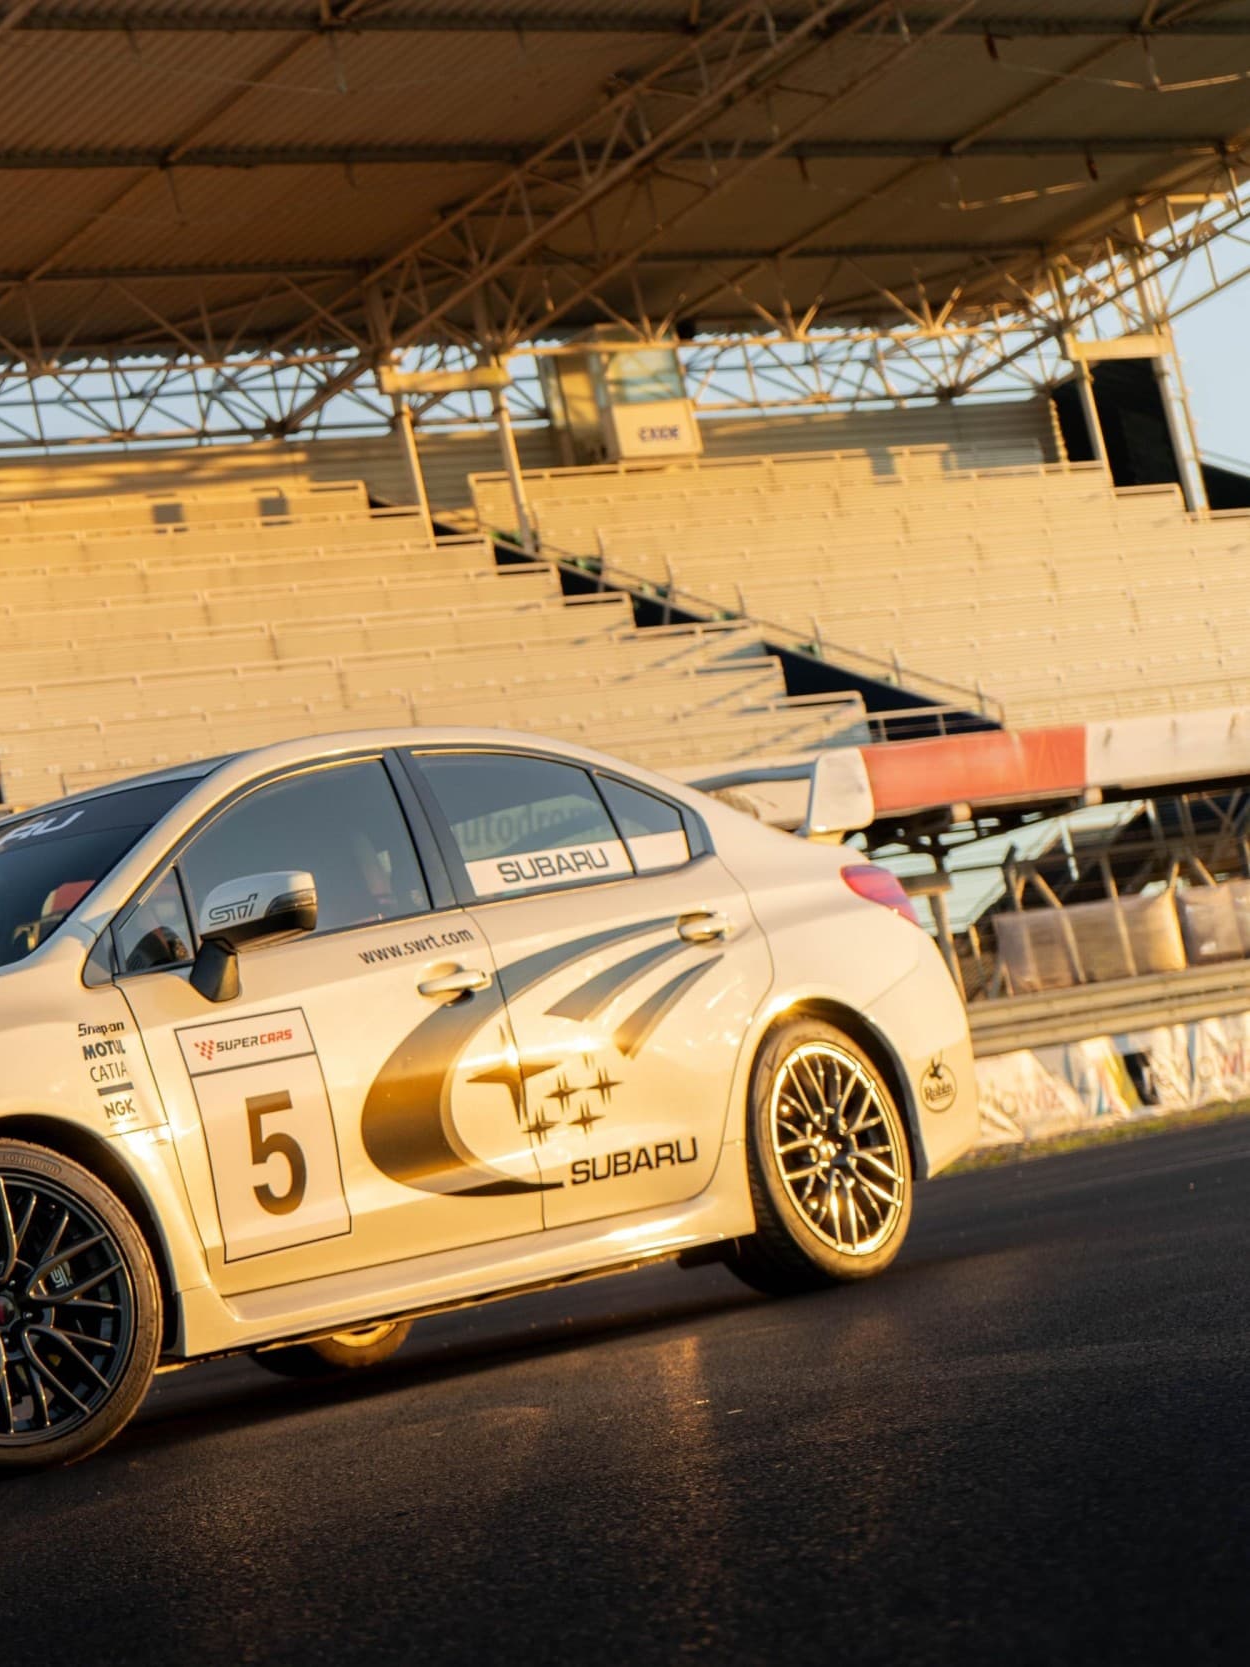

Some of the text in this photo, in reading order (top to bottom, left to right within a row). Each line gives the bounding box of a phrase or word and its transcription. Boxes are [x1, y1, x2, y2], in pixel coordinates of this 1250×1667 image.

[497, 848, 610, 884] SUBARU
[358, 928, 474, 964] www.swrt.com
[82, 1039, 126, 1061] MOTUL
[89, 1063, 127, 1083] CATIA
[103, 1098, 136, 1119] NGK
[244, 1089, 307, 1216] 5
[571, 1136, 698, 1186] SUBARU
